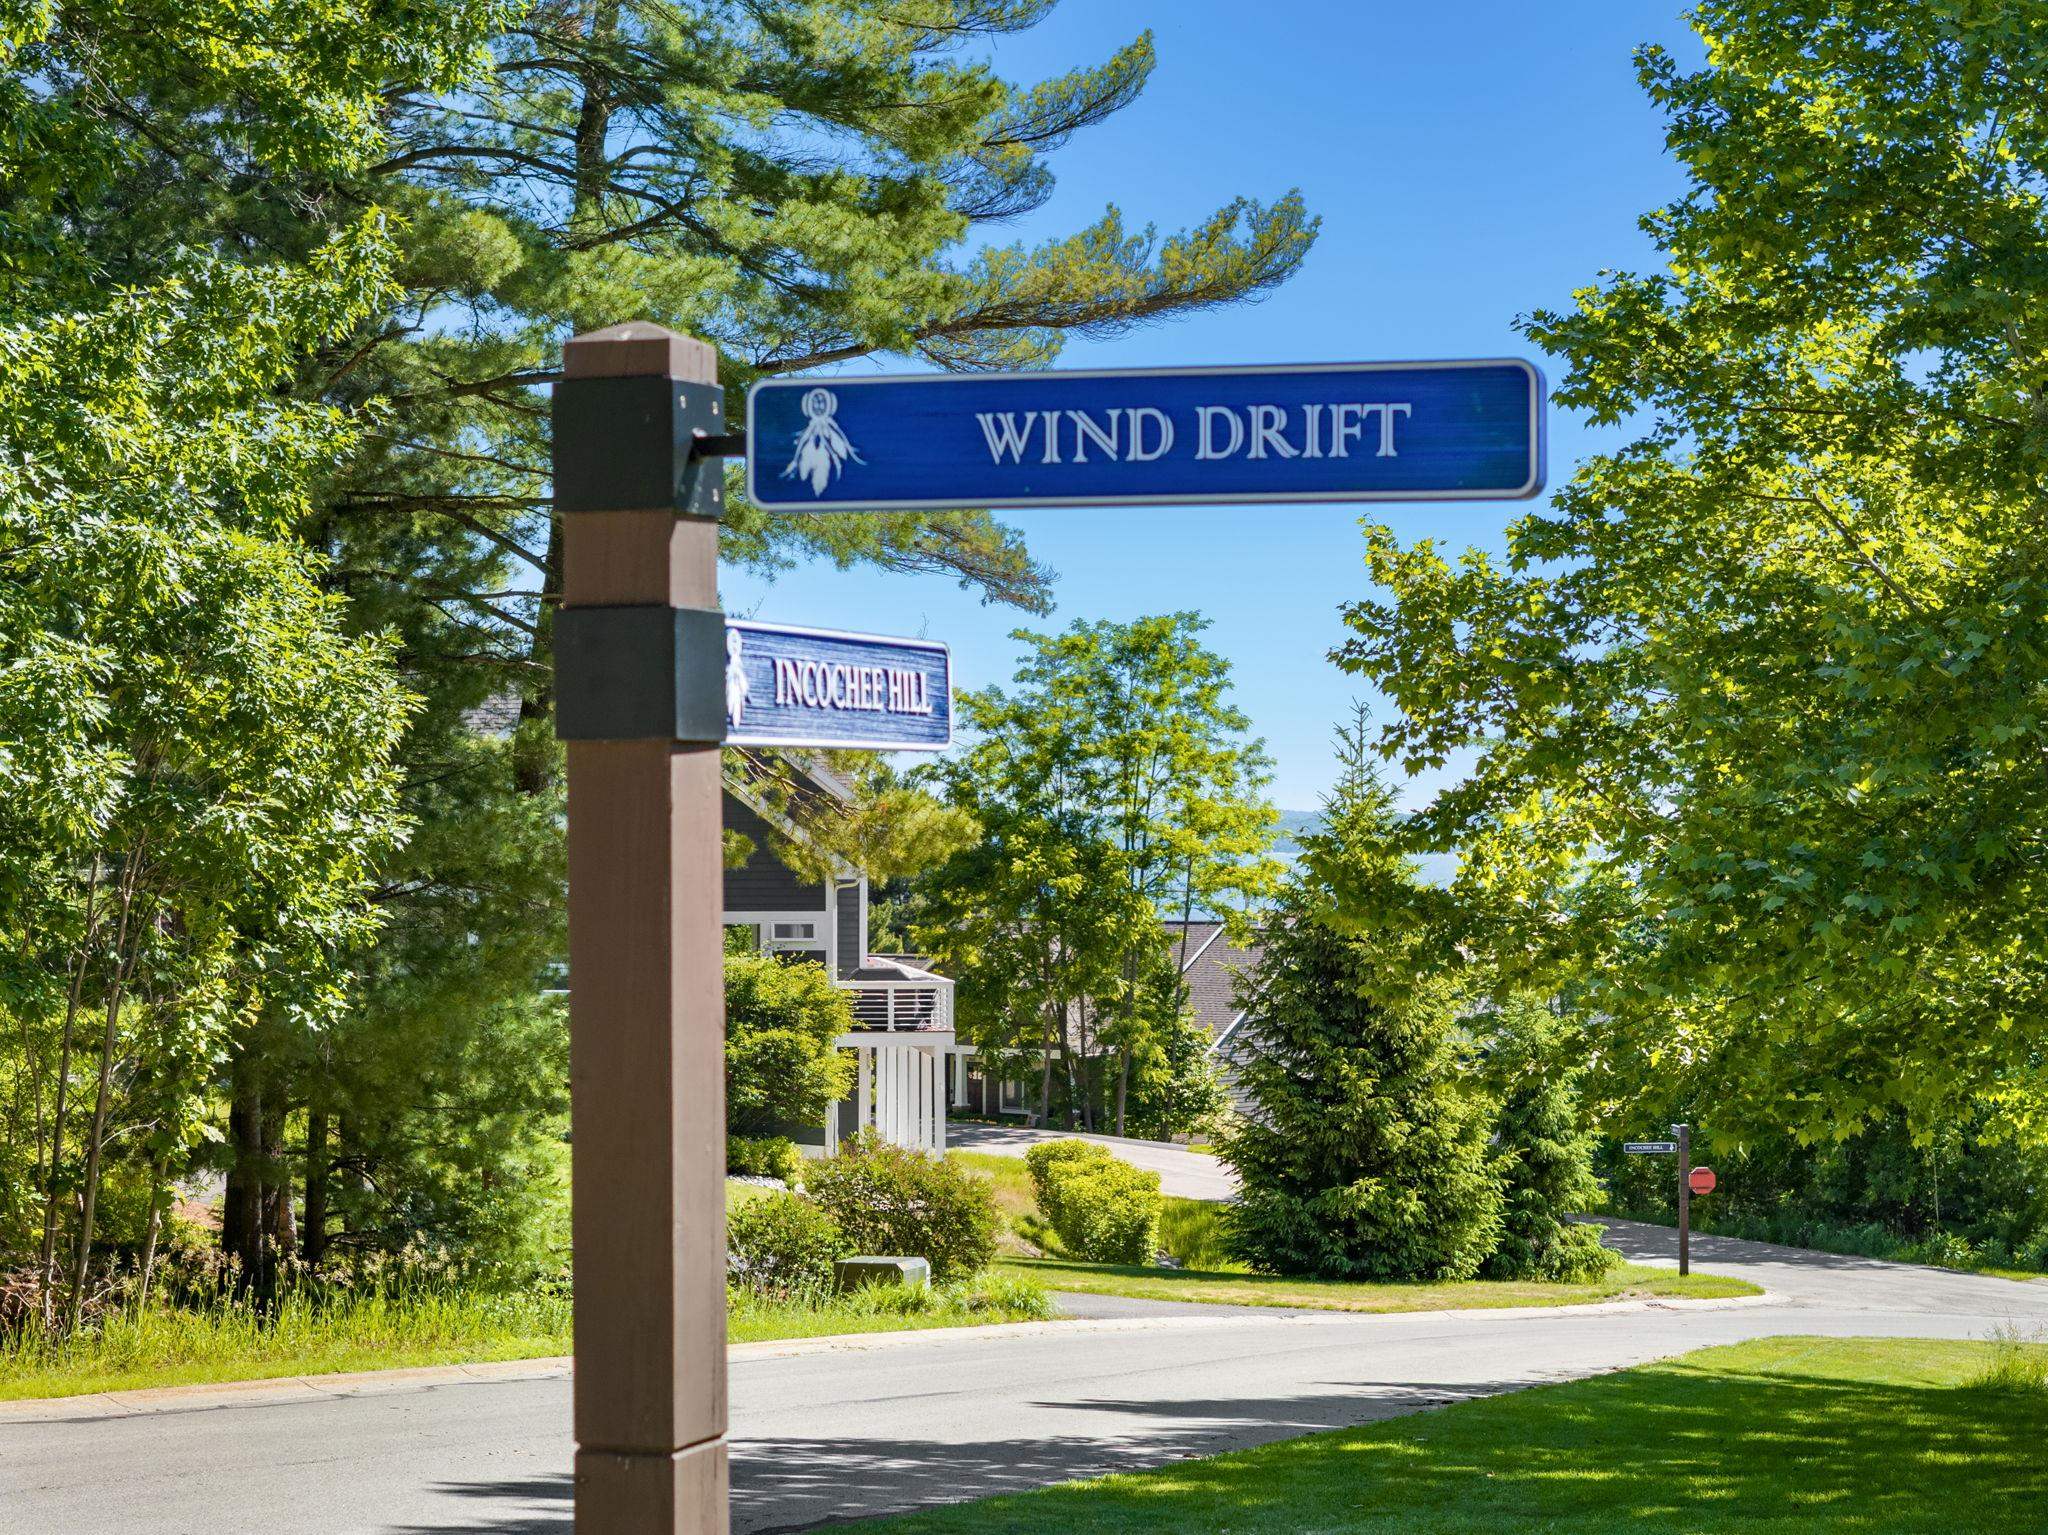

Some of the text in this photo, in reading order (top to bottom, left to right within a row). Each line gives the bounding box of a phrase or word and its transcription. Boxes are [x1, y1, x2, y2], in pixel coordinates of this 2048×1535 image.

[975, 403, 1412, 465] WIND DRIFT
[774, 658, 933, 714] INCOCHEE HILL
